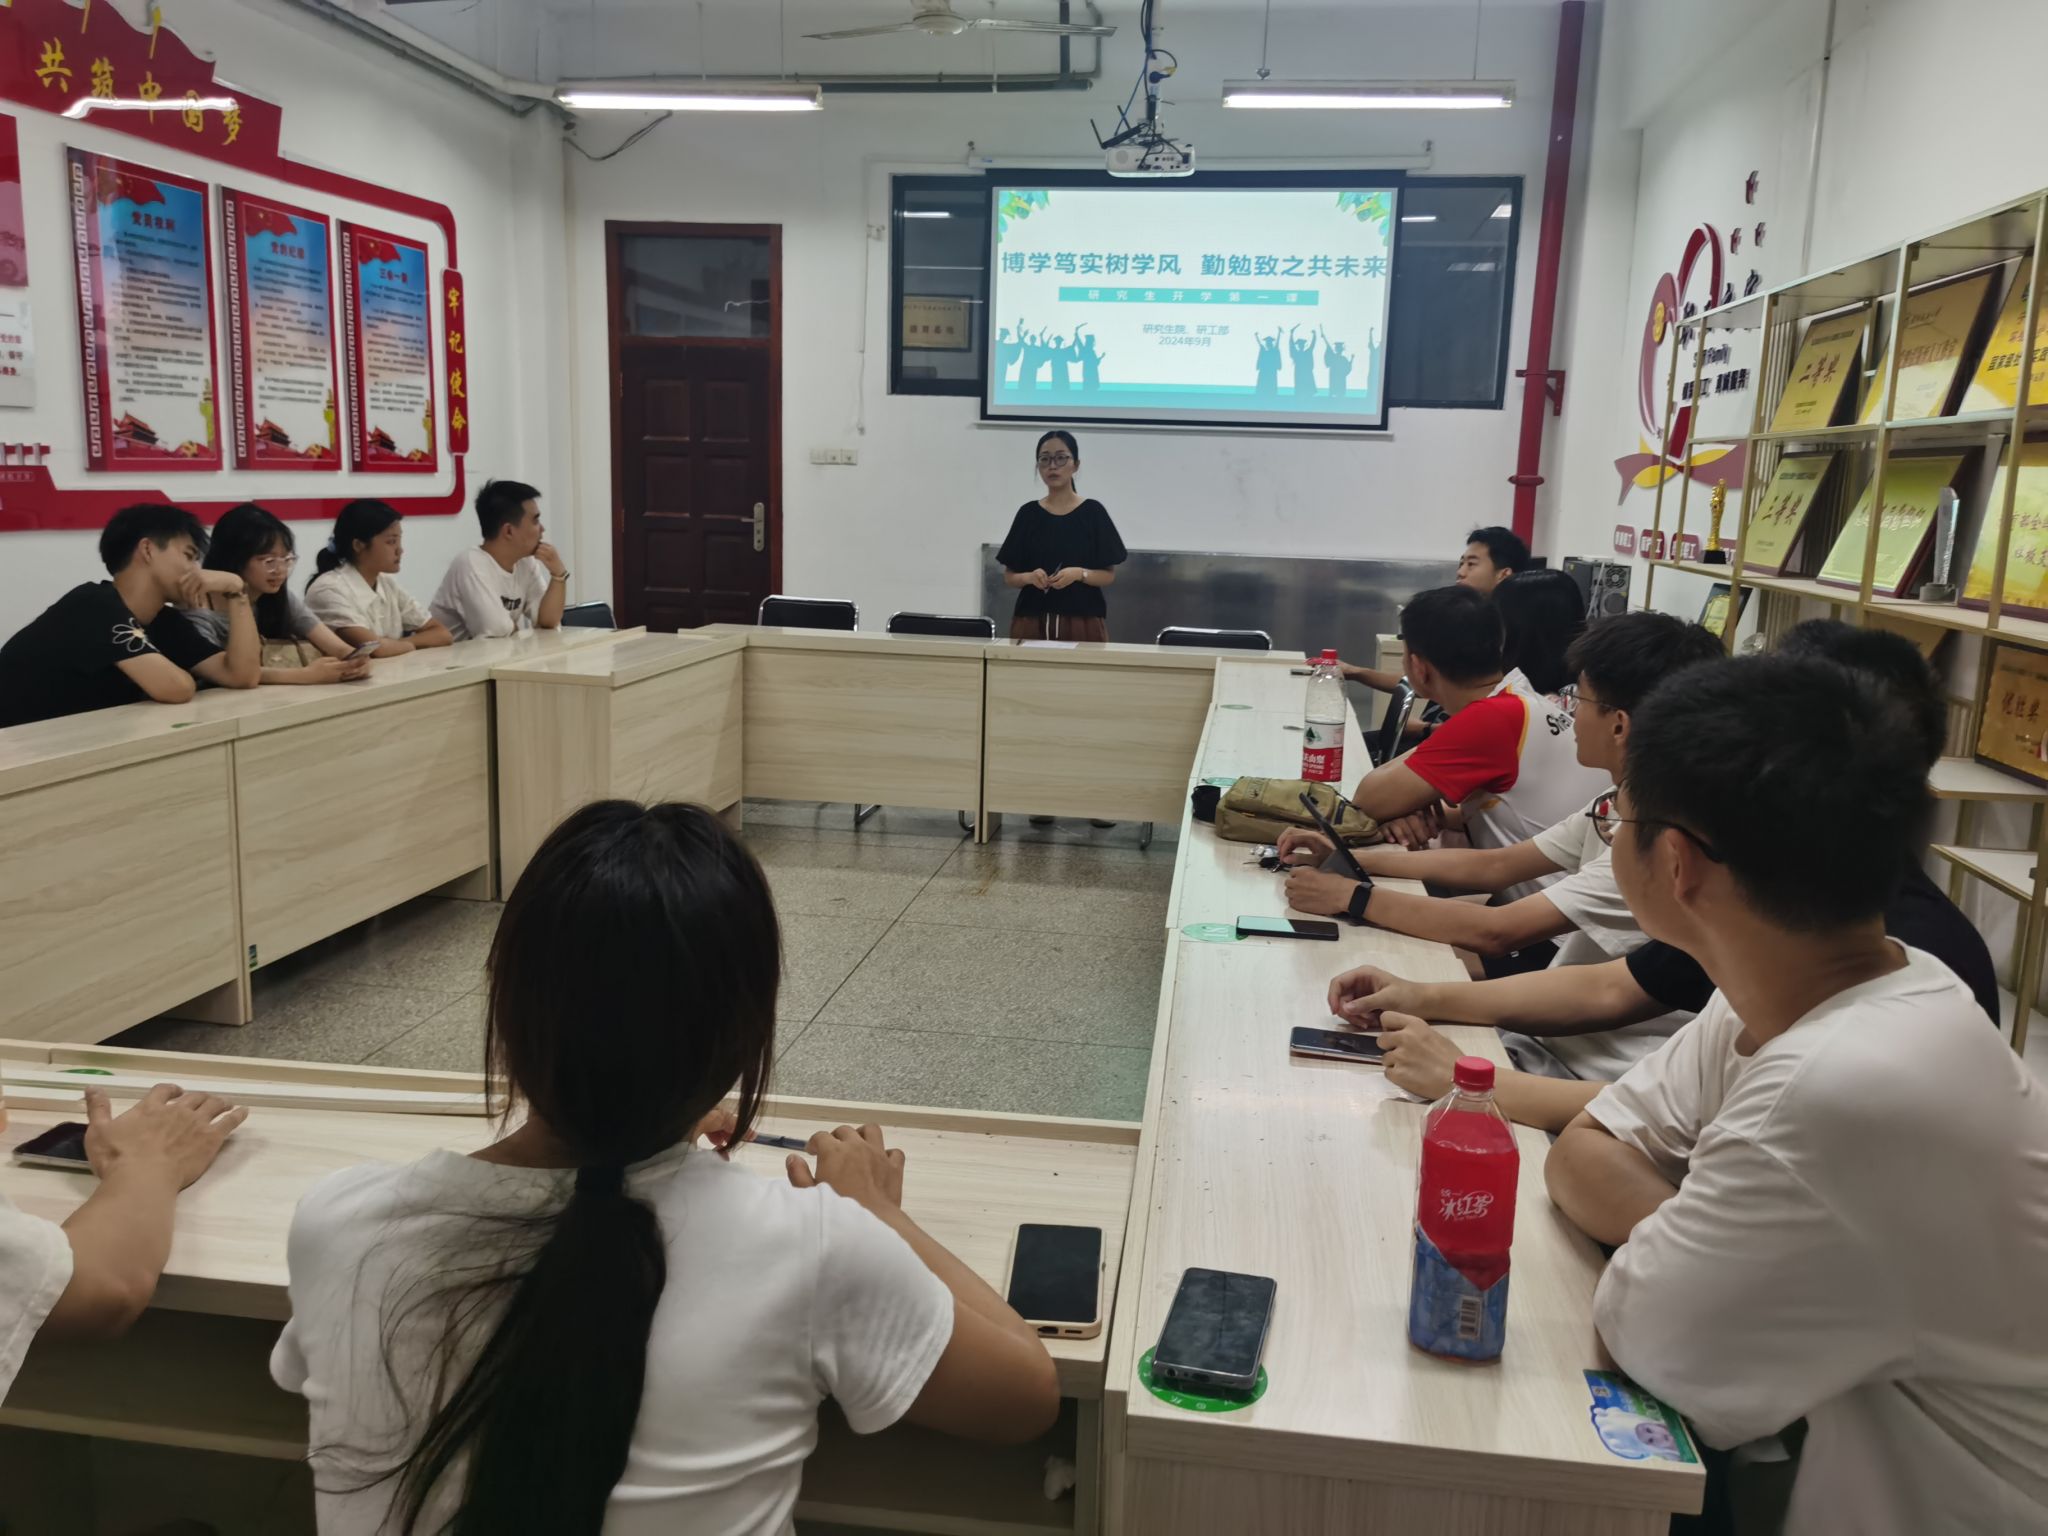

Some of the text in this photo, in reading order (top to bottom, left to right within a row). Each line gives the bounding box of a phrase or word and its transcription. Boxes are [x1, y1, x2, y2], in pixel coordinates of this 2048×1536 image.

[35, 37, 244, 146] 共筑中国梦
[1001, 251, 1387, 278] 博学笃实树学风 勤勉致之共未来
[1158, 336, 1212, 348] 2024年9月
[448, 287, 467, 439] 牢记使命
[1439, 1193, 1491, 1221] 冰红茶
